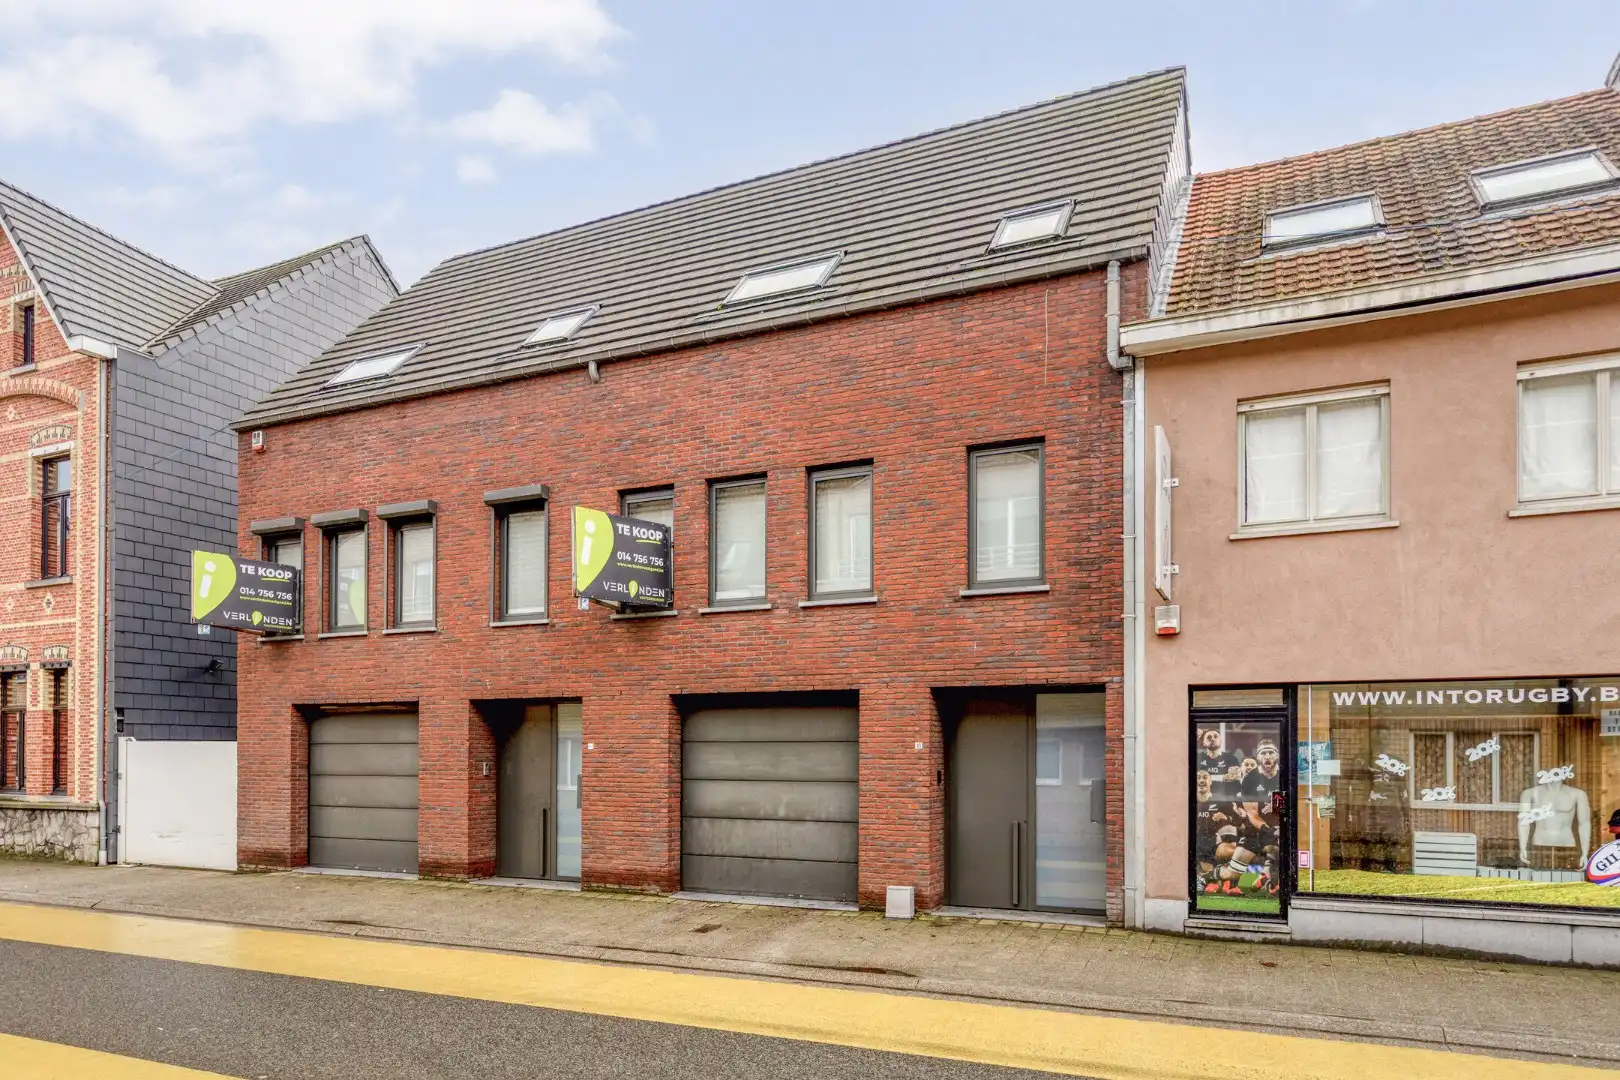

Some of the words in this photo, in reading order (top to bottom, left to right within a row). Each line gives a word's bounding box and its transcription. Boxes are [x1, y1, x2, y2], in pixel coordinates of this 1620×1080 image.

[616, 523, 631, 536] TE
[633, 526, 663, 541] KOOP
[617, 551, 632, 561] 014
[633, 554, 648, 564] 756
[650, 556, 664, 567] 756
[240, 564, 255, 575] TE
[258, 567, 292, 580] KOOP
[240, 586, 256, 595] 014
[258, 589, 274, 598] 756
[276, 591, 292, 601] 756
[1465, 736, 1501, 762] 20%
[1375, 753, 1411, 777] 20%
[1536, 764, 1575, 784] 20%
[1421, 785, 1456, 802] 20%
